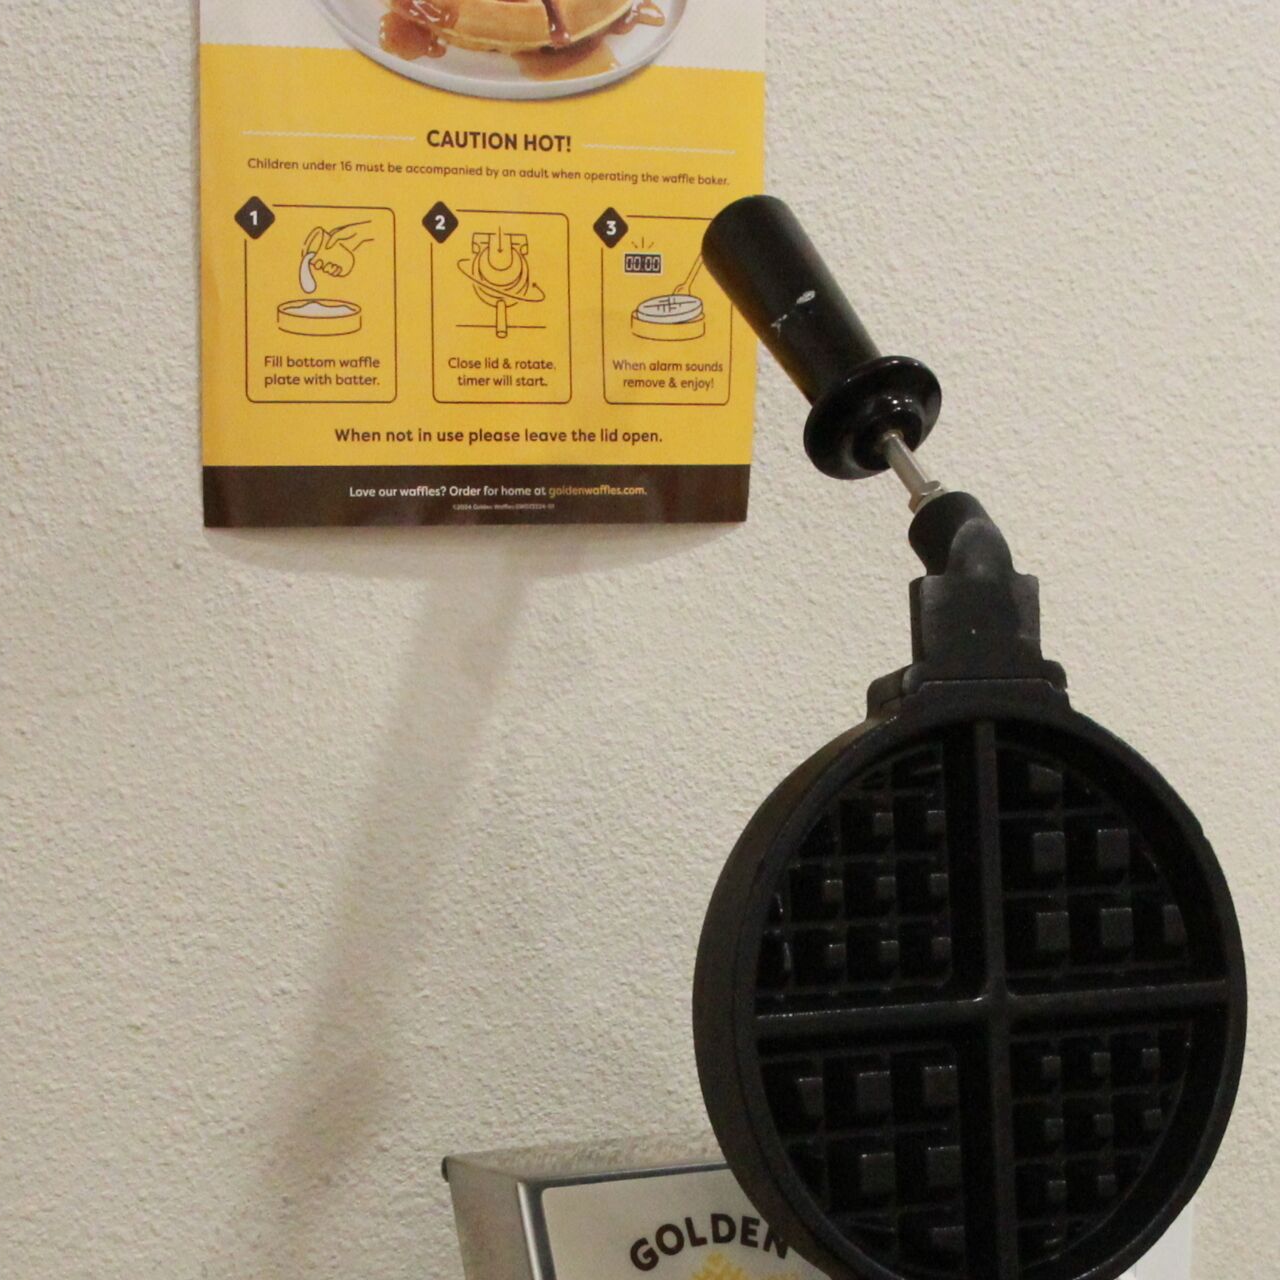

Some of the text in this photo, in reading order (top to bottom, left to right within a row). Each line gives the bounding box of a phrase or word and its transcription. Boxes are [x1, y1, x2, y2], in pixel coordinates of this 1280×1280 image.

[426, 129, 573, 153] CAUTION HOT!
[247, 157, 731, 186] Children under 16 must be accompanied by an adult when operating the waffle baker.
[249, 210, 259, 226] 1
[435, 215, 446, 230] 2
[606, 220, 617, 235] 3
[624, 255, 661, 272] 00:00
[264, 356, 380, 369] Fill bottom waffle
[448, 357, 481, 369] Close
[484, 358, 498, 370] lid
[502, 358, 512, 370] &
[612, 359, 724, 373] When alarm sounds
[264, 374, 380, 389] plate with batter.
[457, 375, 548, 388] timer will start.
[623, 377, 715, 392] remove & enjoy!
[334, 428, 663, 447] When not in use please leave the lid open.
[349, 484, 648, 499] Love our waffles? Order for home at goldenwaffles.com.
